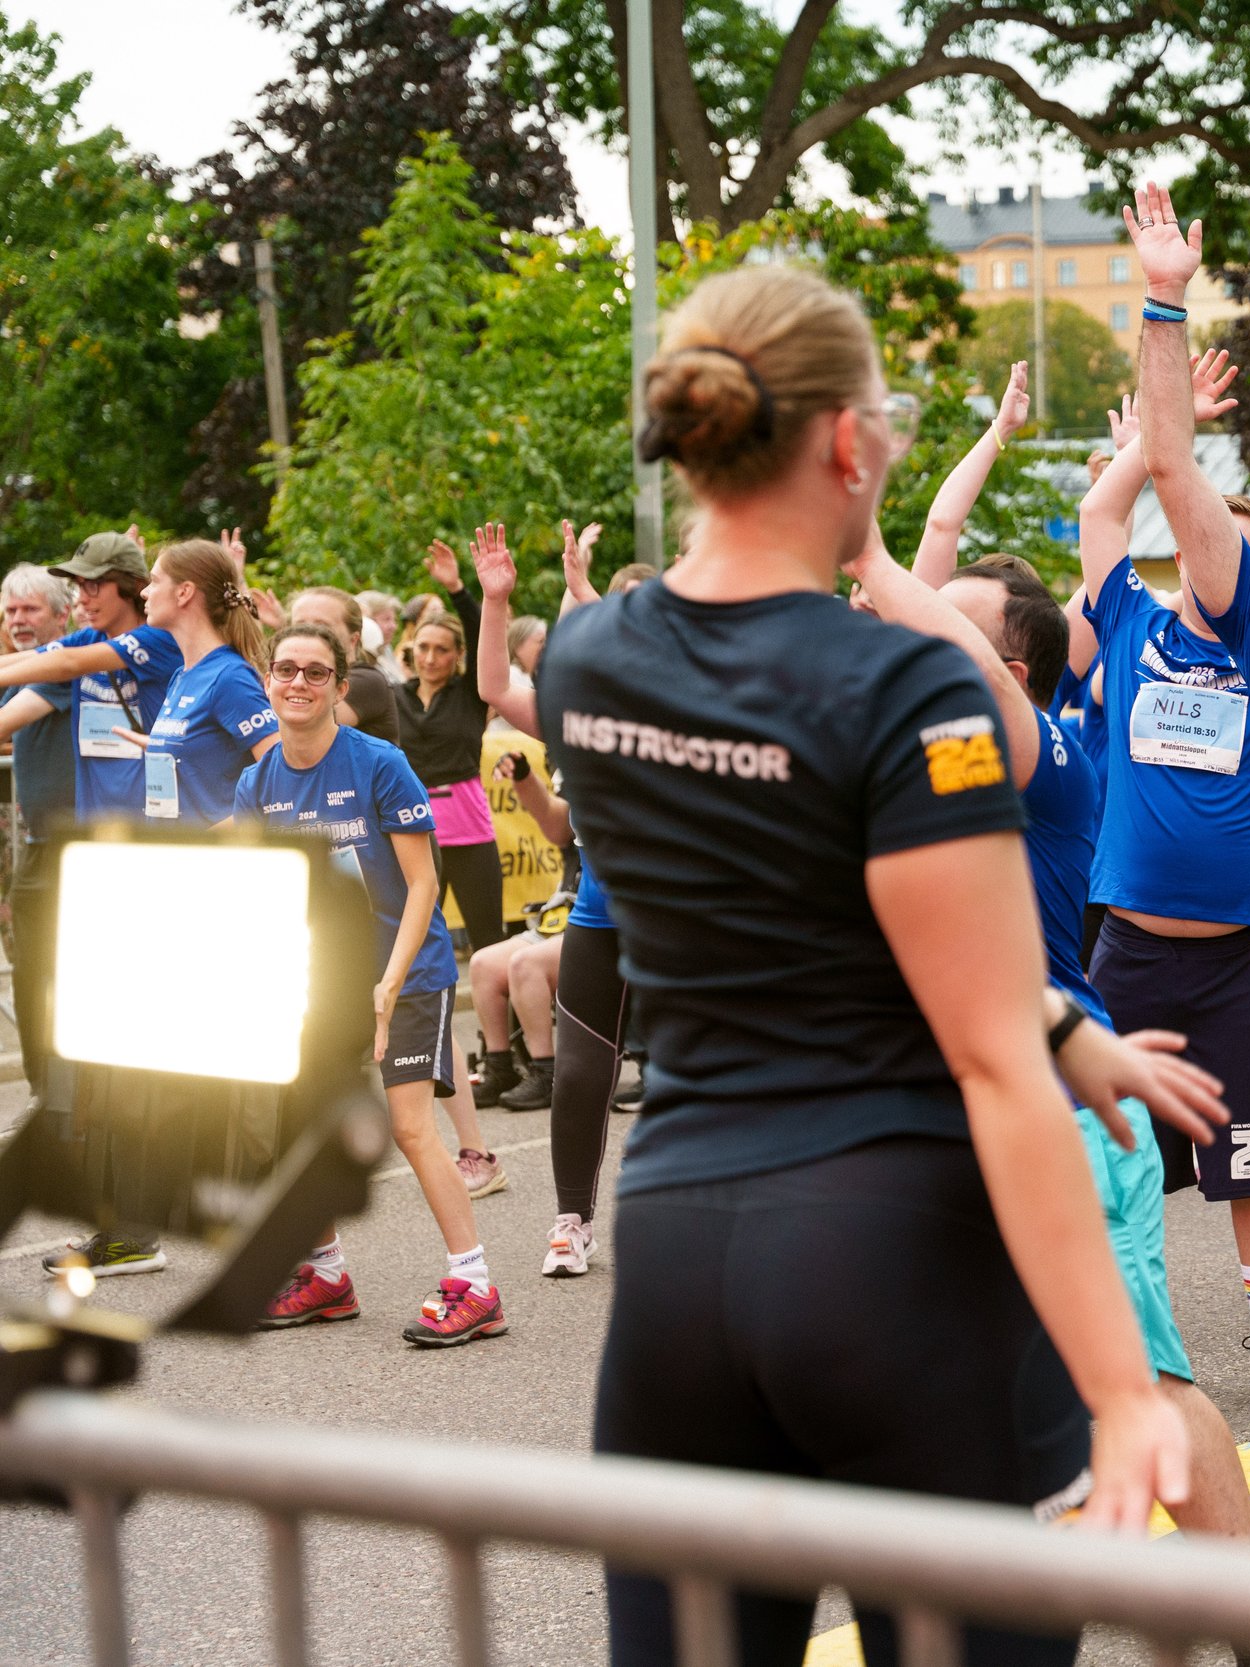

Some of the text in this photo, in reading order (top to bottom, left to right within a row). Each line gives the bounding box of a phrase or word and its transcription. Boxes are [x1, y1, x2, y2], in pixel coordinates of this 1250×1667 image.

[1190, 666, 1215, 677] 2026
[1153, 698, 1202, 719] NILS
[1157, 722, 1217, 737] Starttid 18:30
[562, 710, 792, 782] INSTRUCTOR
[1160, 742, 1207, 755] Midnattsloppet
[327, 790, 355, 799] VITAMIN
[328, 798, 344, 806] WELL
[394, 1055, 425, 1067] CRAFT
